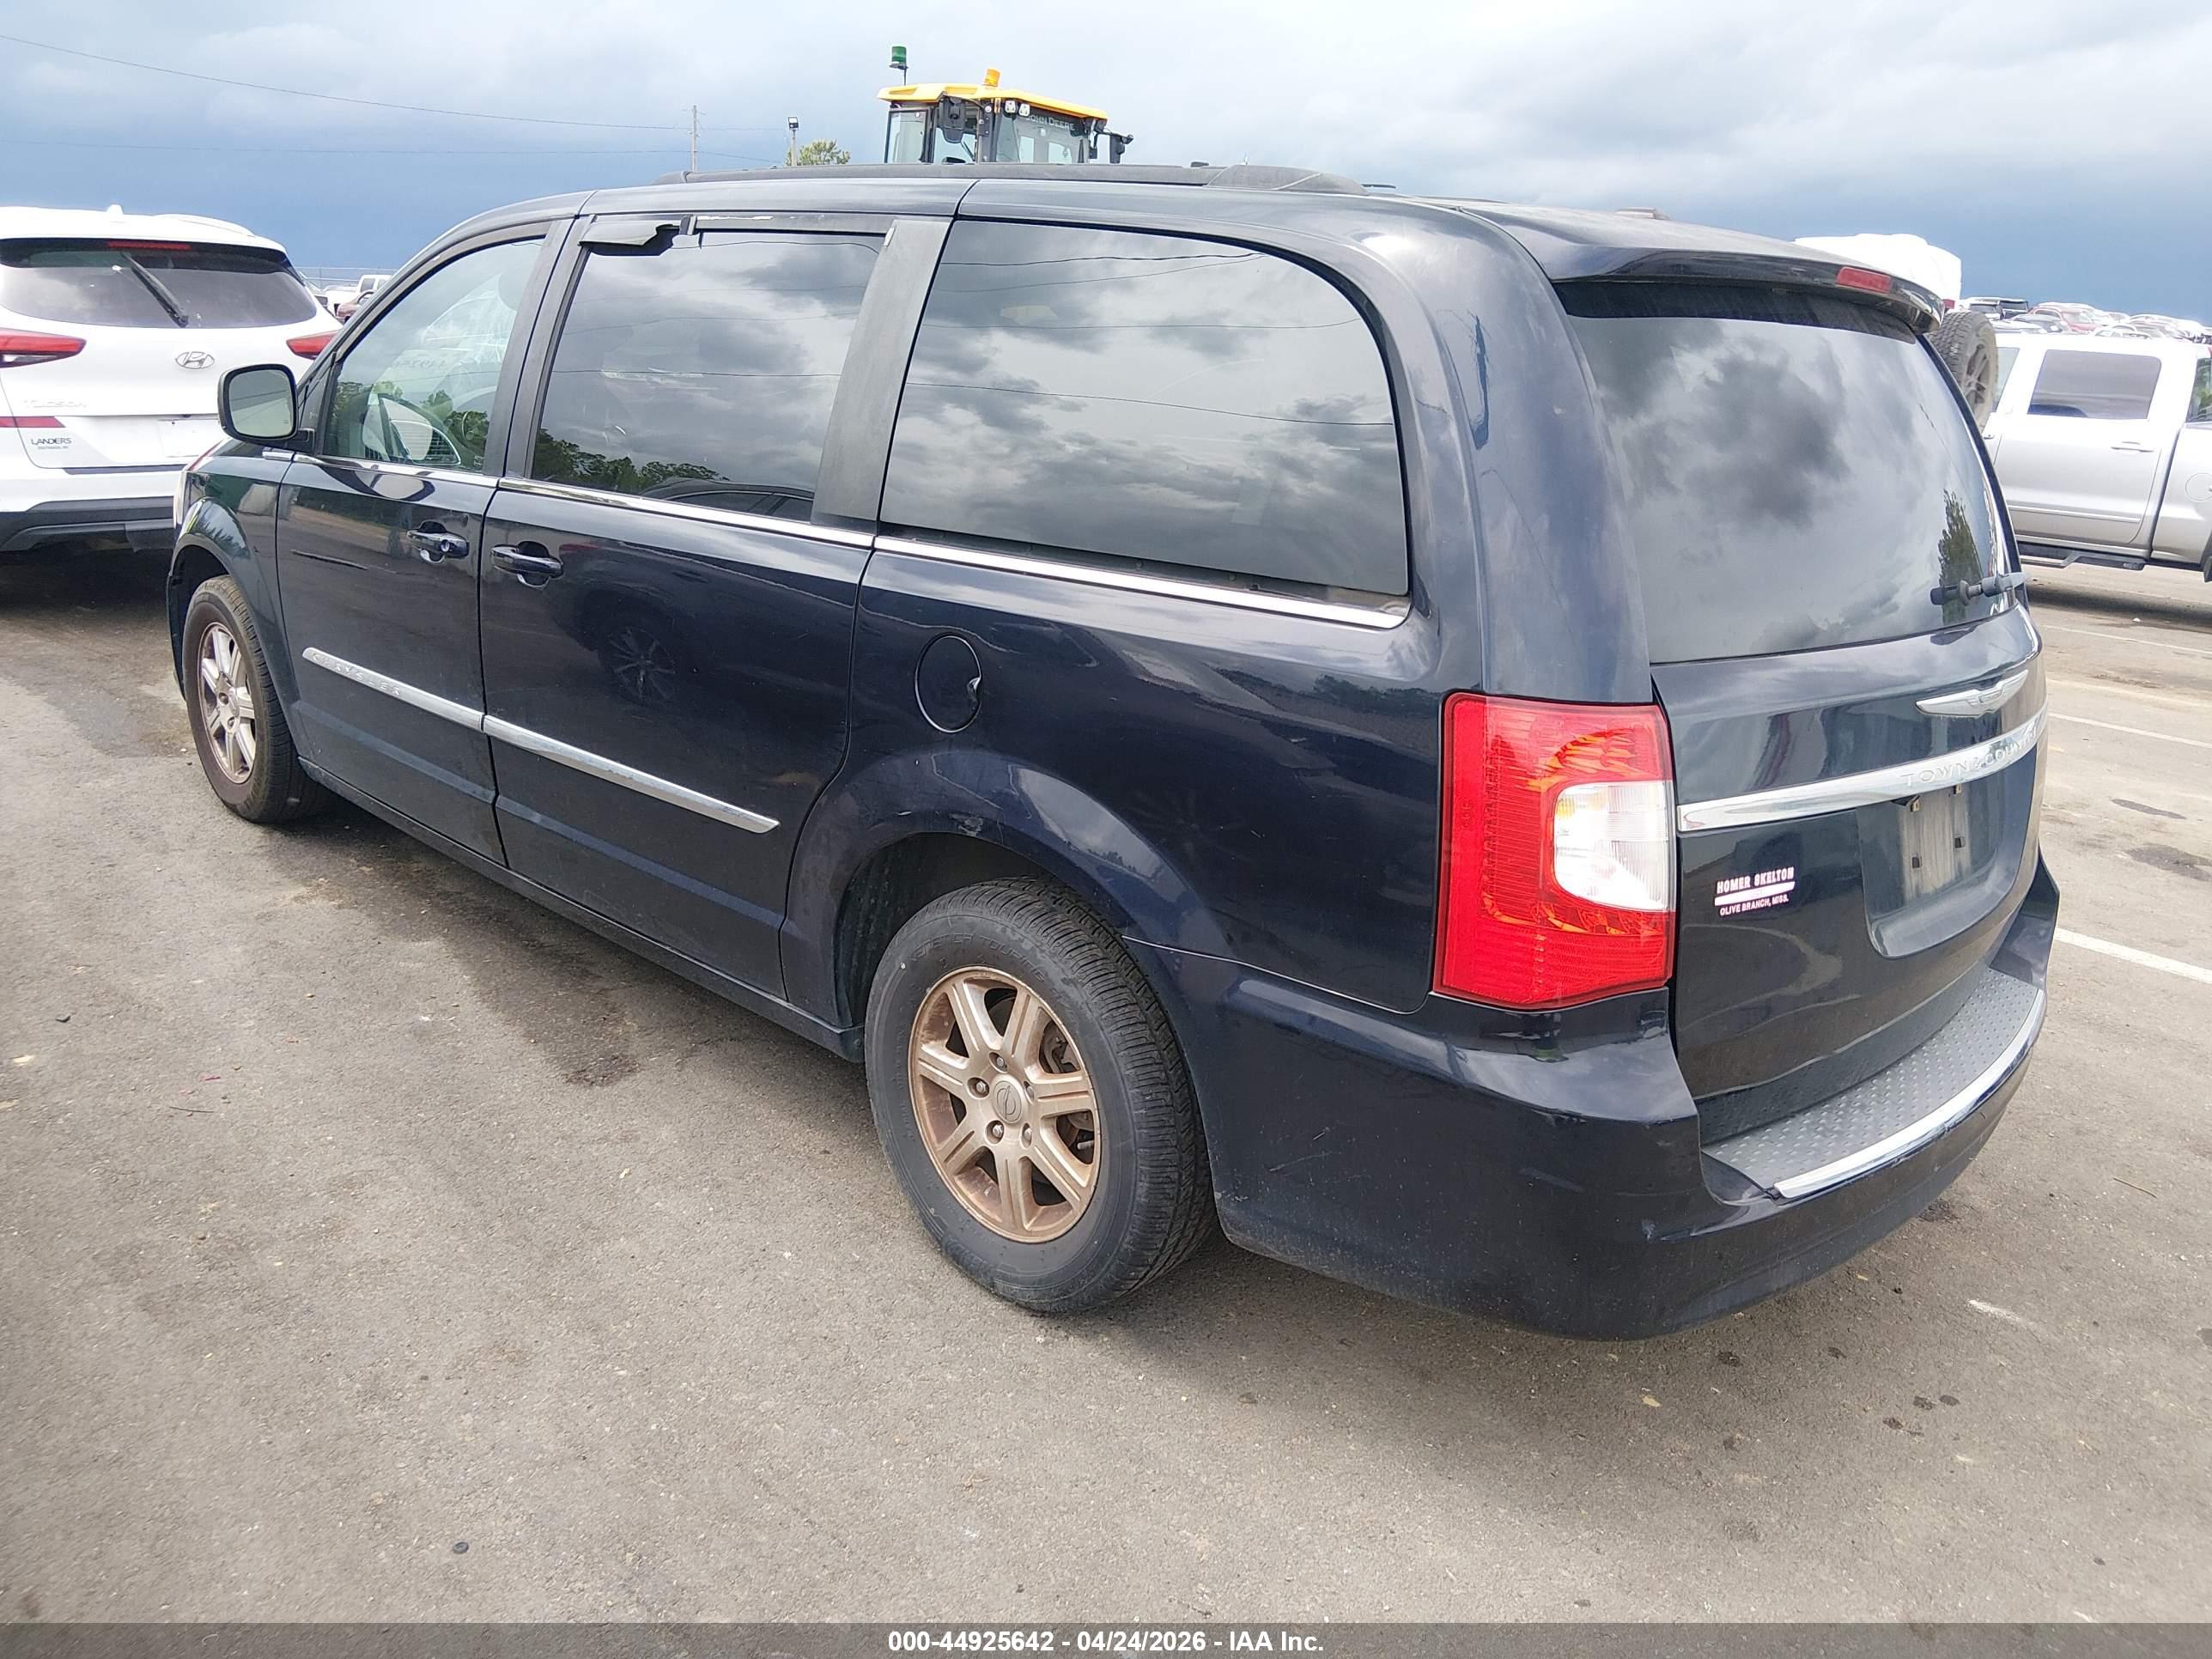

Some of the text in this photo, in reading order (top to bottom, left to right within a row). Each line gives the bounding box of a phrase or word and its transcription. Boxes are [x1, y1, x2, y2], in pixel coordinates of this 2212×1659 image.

[1048, 117, 1075, 131] DEERE
[1901, 760, 1968, 787] TOWN
[1717, 876, 1751, 894] HOMER
[1753, 866, 1795, 886] SKELTON
[1719, 894, 1790, 916] OLIVE BRANCH, MISS.
